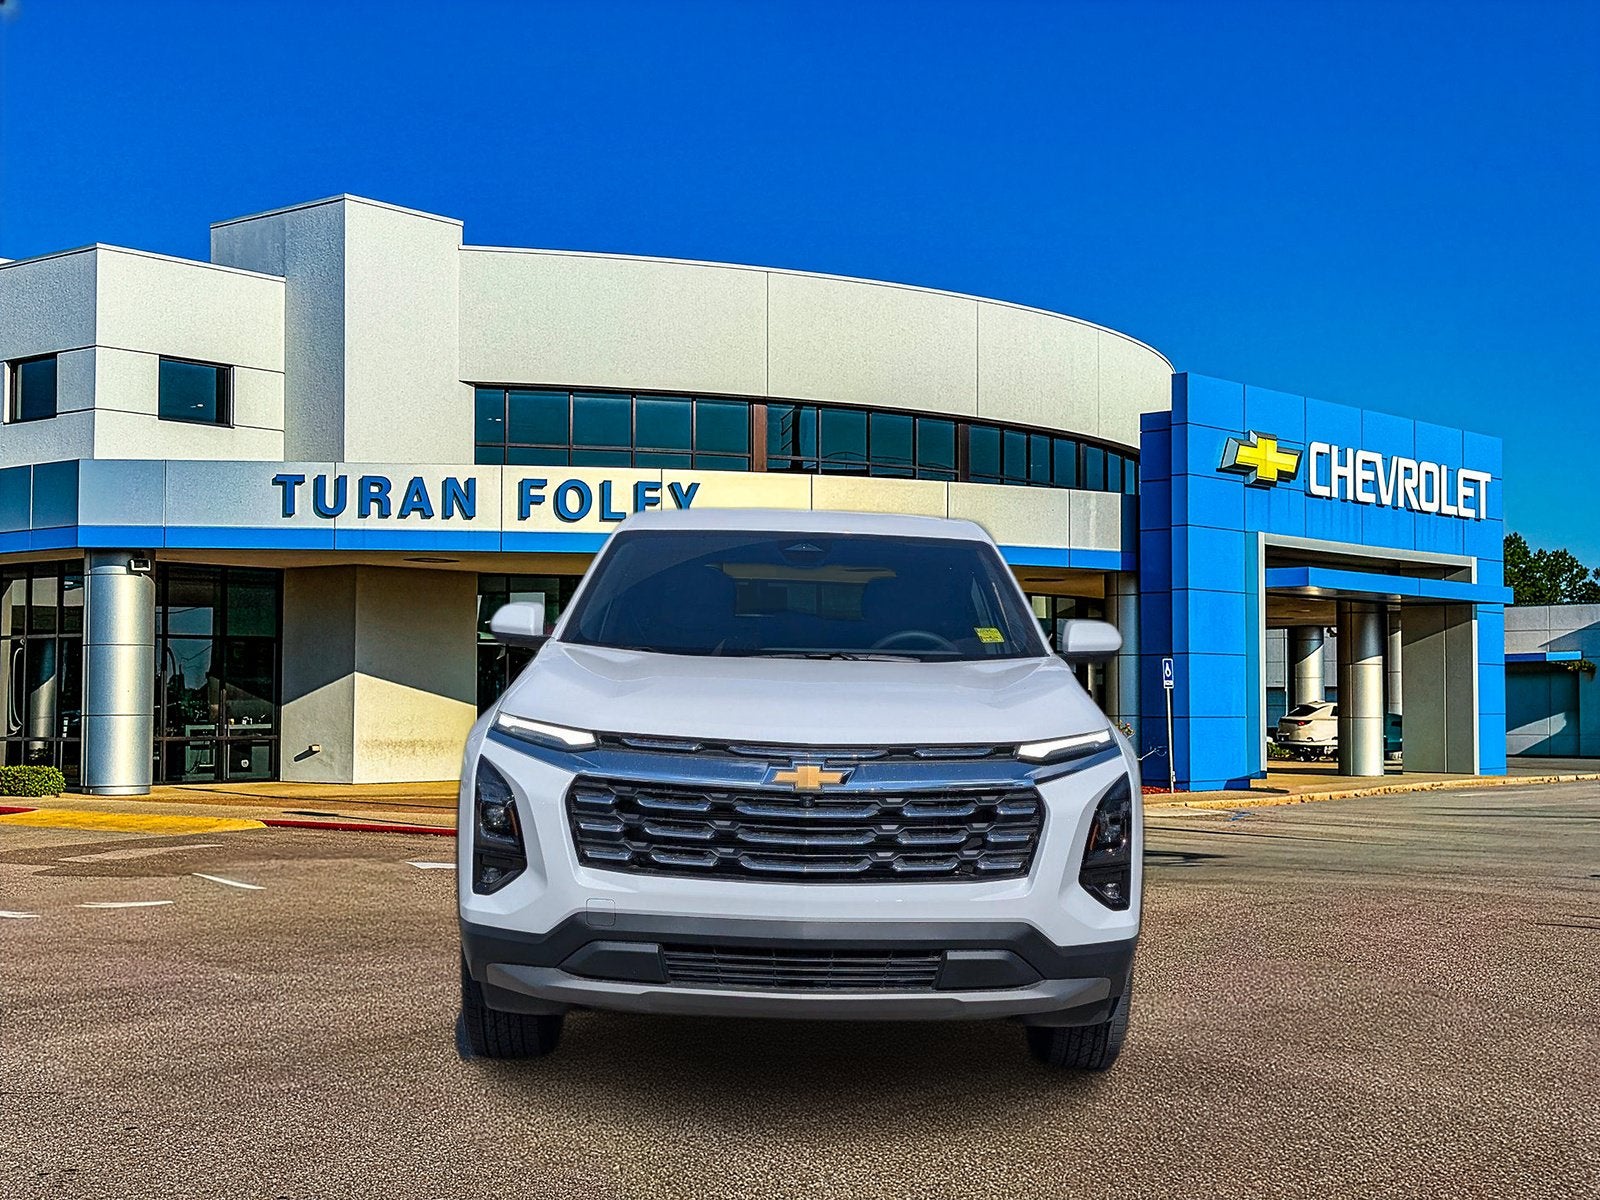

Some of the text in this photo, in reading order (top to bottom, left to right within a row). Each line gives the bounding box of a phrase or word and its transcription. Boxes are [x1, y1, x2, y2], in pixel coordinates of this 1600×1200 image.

[272, 474, 701, 522] TURAN FOLEY
[1308, 441, 1492, 519] CHEVROLET
